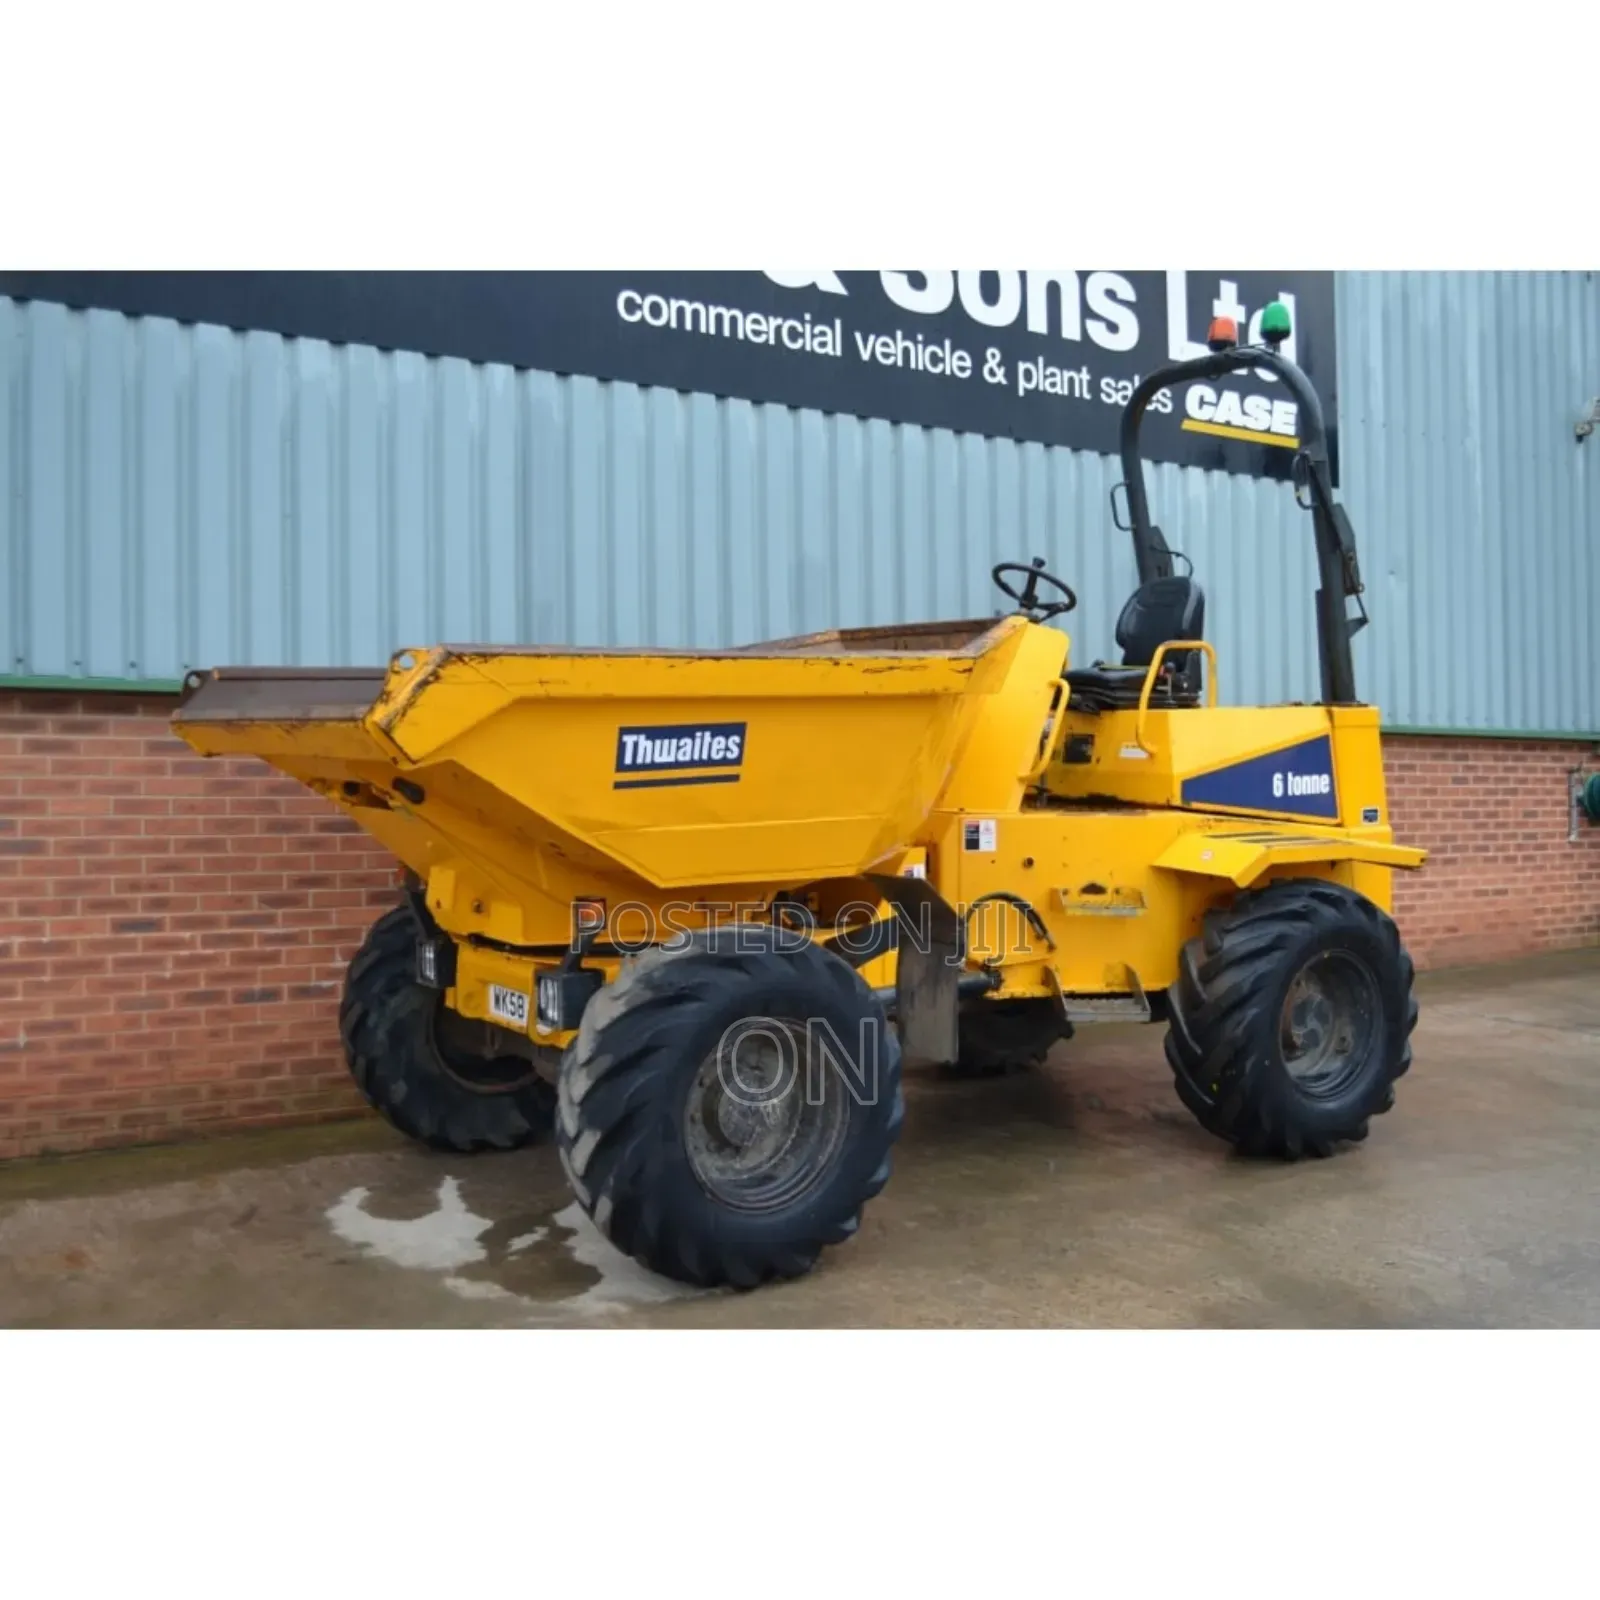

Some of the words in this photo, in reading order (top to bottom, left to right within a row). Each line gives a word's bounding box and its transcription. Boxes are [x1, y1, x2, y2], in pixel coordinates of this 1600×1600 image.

[616, 289, 842, 357] commercial
[854, 330, 972, 379] vehicle
[982, 347, 1008, 385] &
[1017, 355, 1092, 400] plant
[1184, 383, 1299, 437] CASE
[621, 730, 741, 766] Thwaites
[1272, 772, 1284, 798] 6
[1287, 771, 1330, 796] tonne
